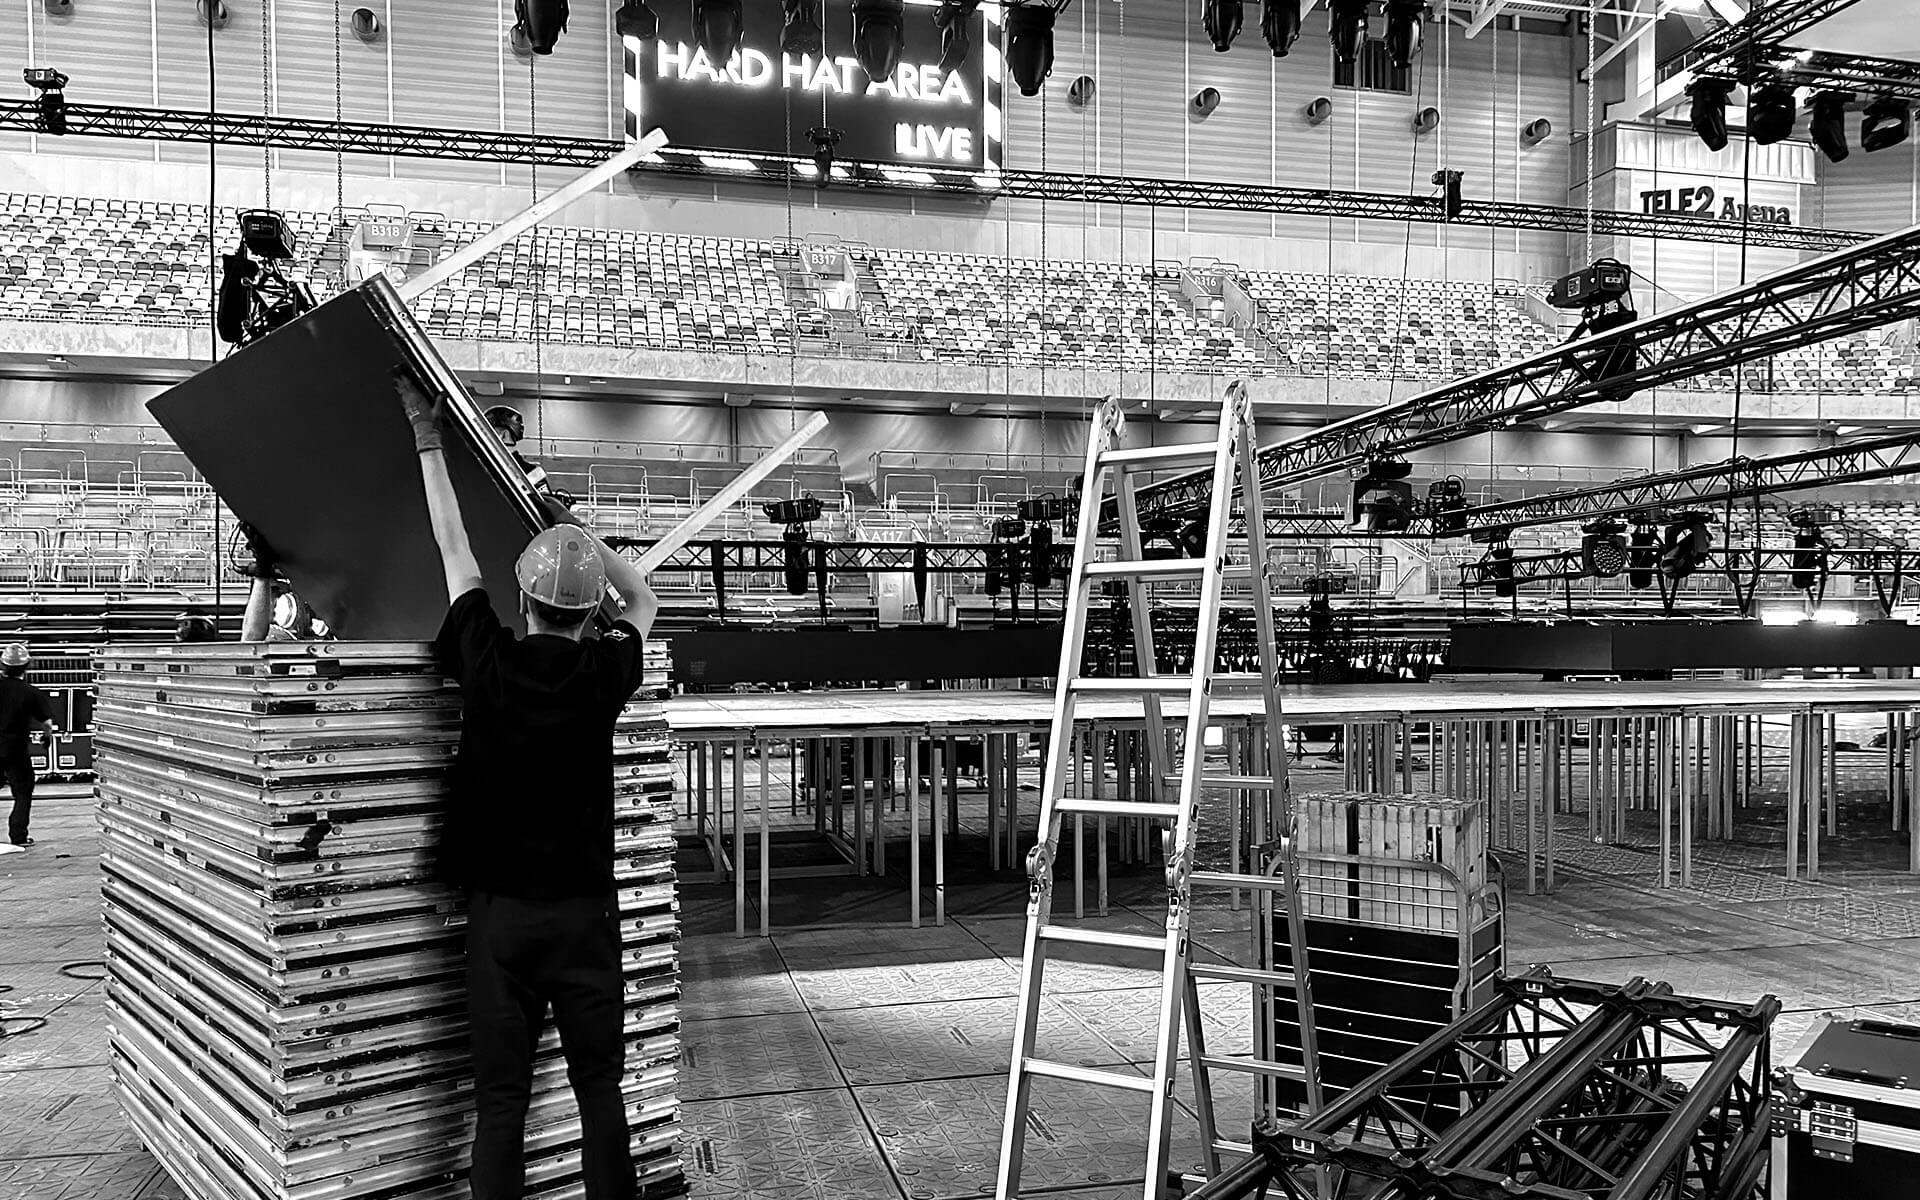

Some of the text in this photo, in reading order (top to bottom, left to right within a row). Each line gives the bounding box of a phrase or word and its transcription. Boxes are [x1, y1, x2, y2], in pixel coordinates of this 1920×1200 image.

[782, 50, 858, 94] HAT
[894, 122, 974, 161] LIVE
[1640, 186, 1791, 225] TELE2 Arena
[371, 224, 400, 237] B318
[811, 253, 836, 265] B317
[871, 530, 903, 541] A117
